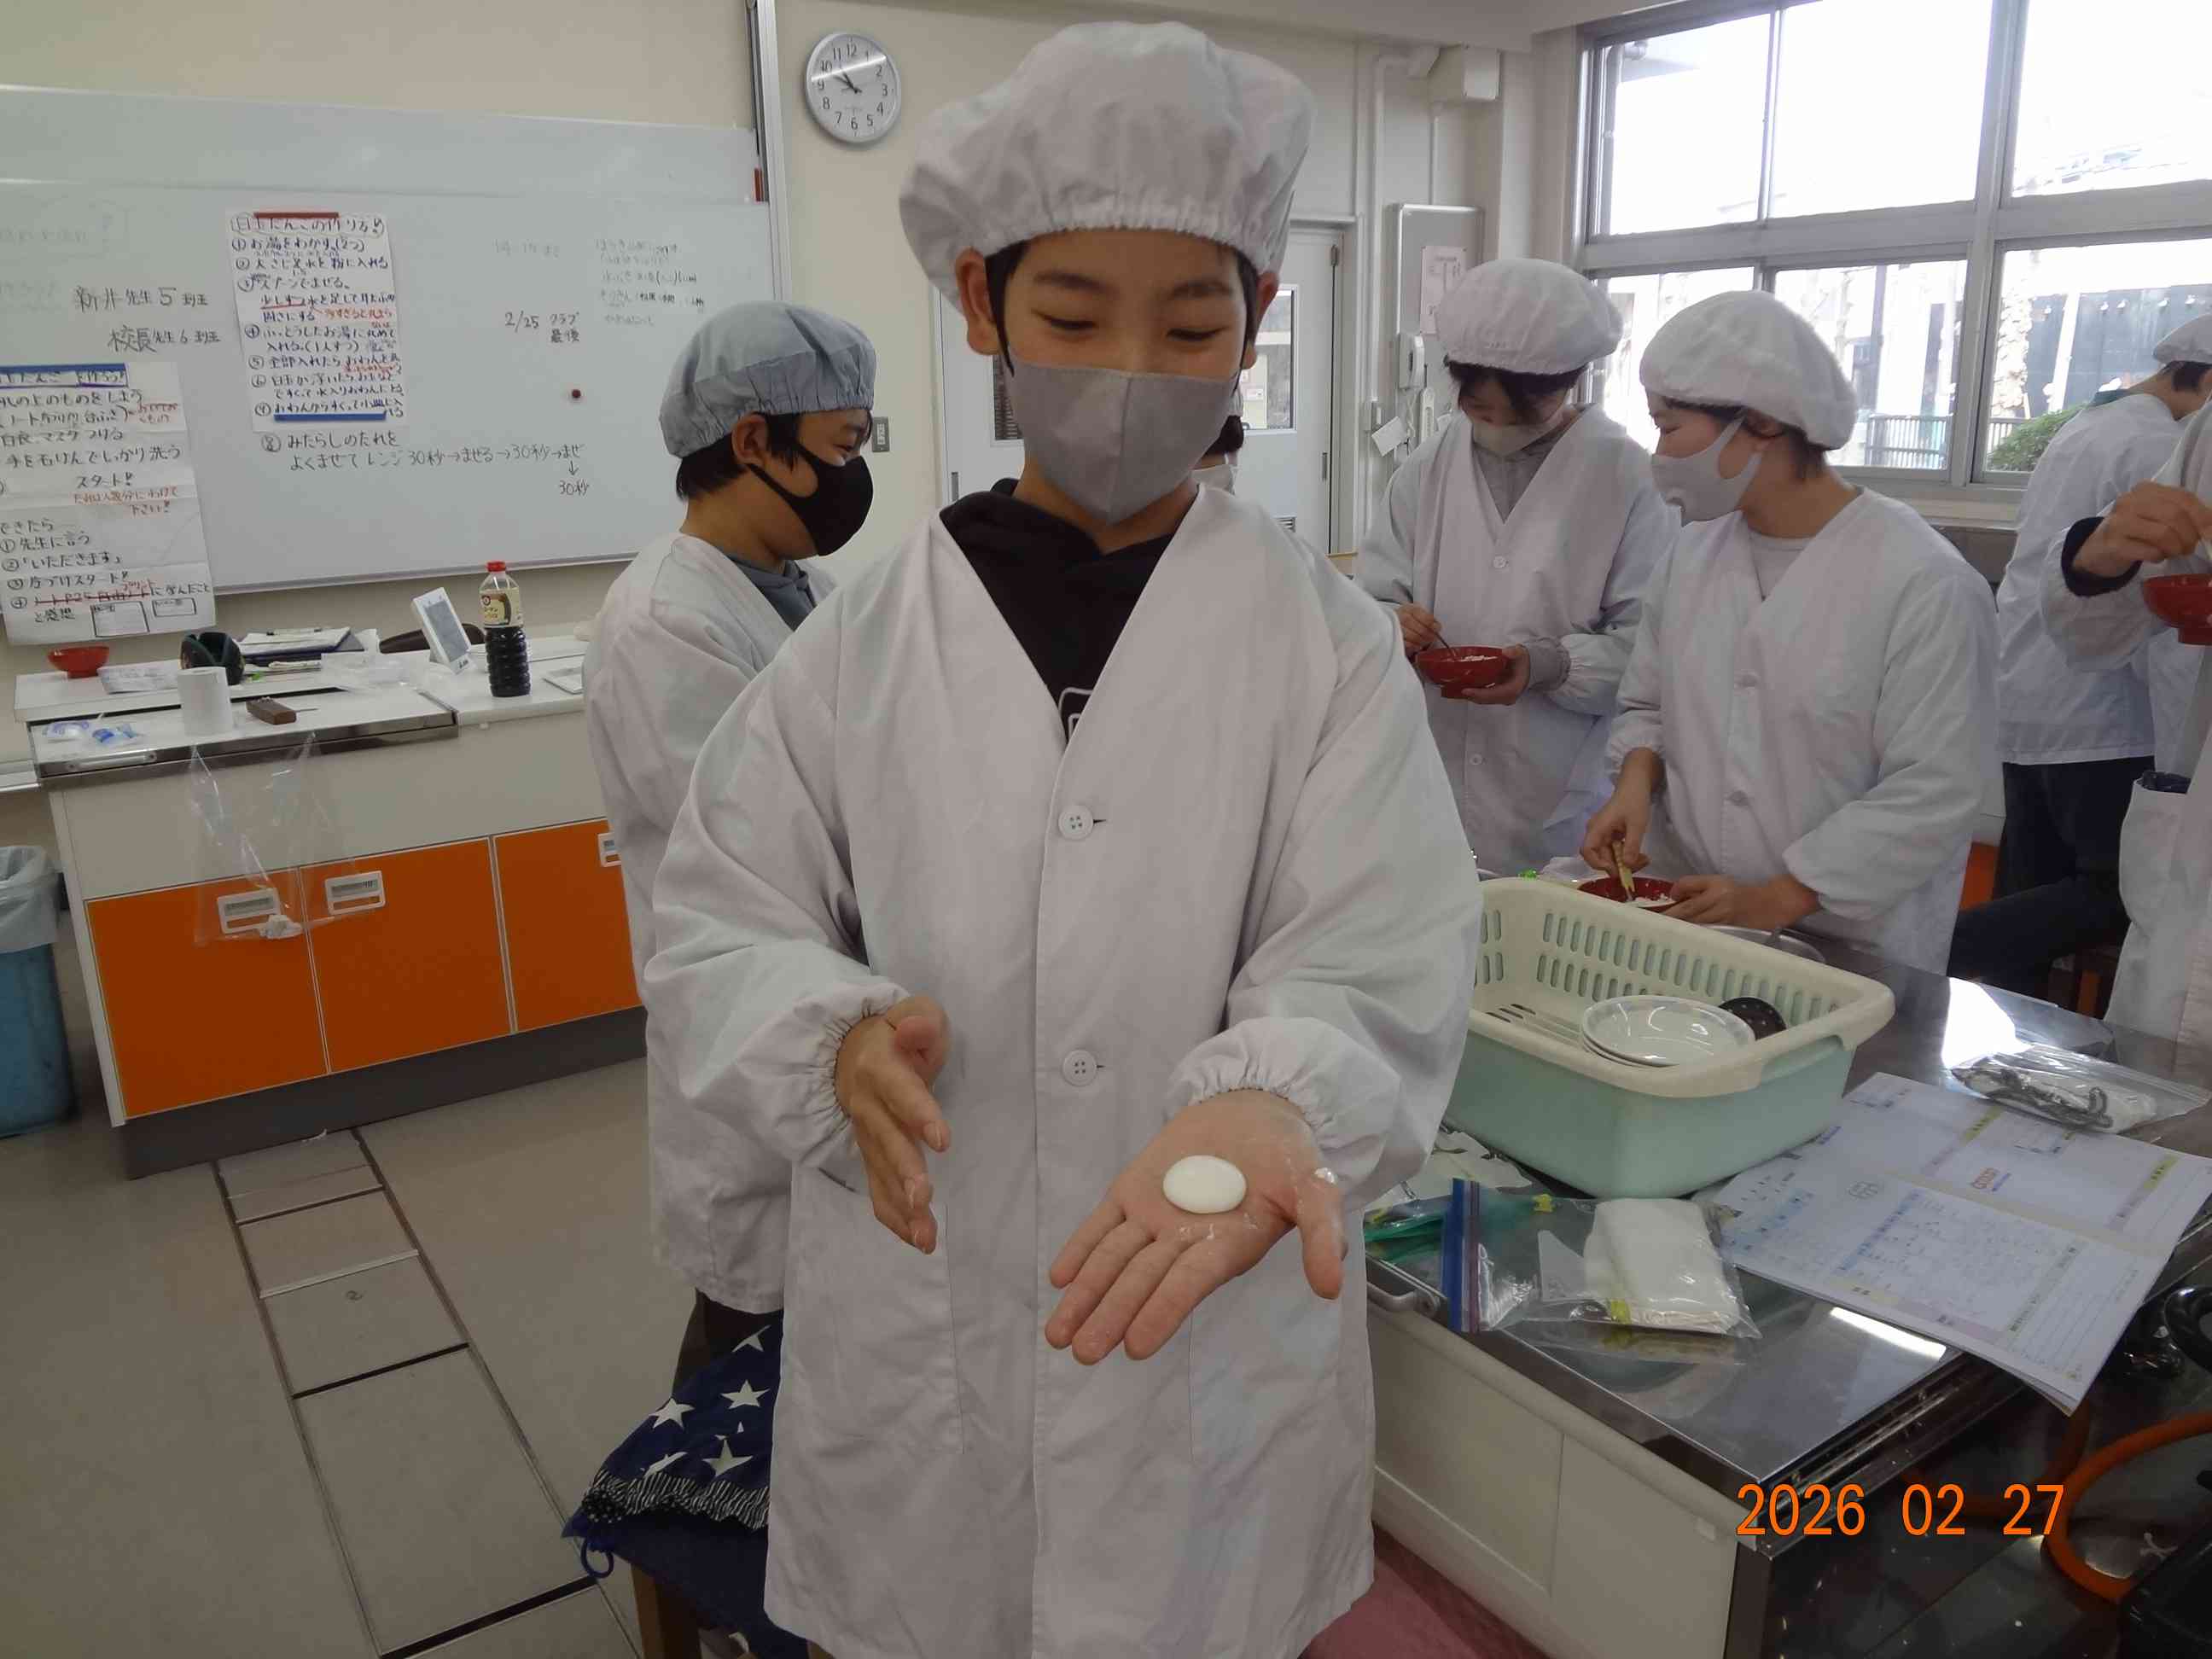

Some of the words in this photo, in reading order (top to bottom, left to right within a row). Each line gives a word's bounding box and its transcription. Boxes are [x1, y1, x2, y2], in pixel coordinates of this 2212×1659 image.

[833, 48, 841, 61] 11
[847, 43, 857, 57] 12
[821, 61, 832, 73] 10
[876, 65, 882, 77] 2
[818, 79, 824, 90] 9
[882, 83, 888, 96] 3
[823, 96, 830, 110] 8
[876, 102, 884, 116] 4
[835, 111, 842, 124] 7
[851, 117, 859, 130] 6
[866, 114, 874, 126] 5
[504, 310, 539, 333] 2/25
[288, 430, 400, 449] みたらしのたれを
[559, 479, 589, 496] 30秒
